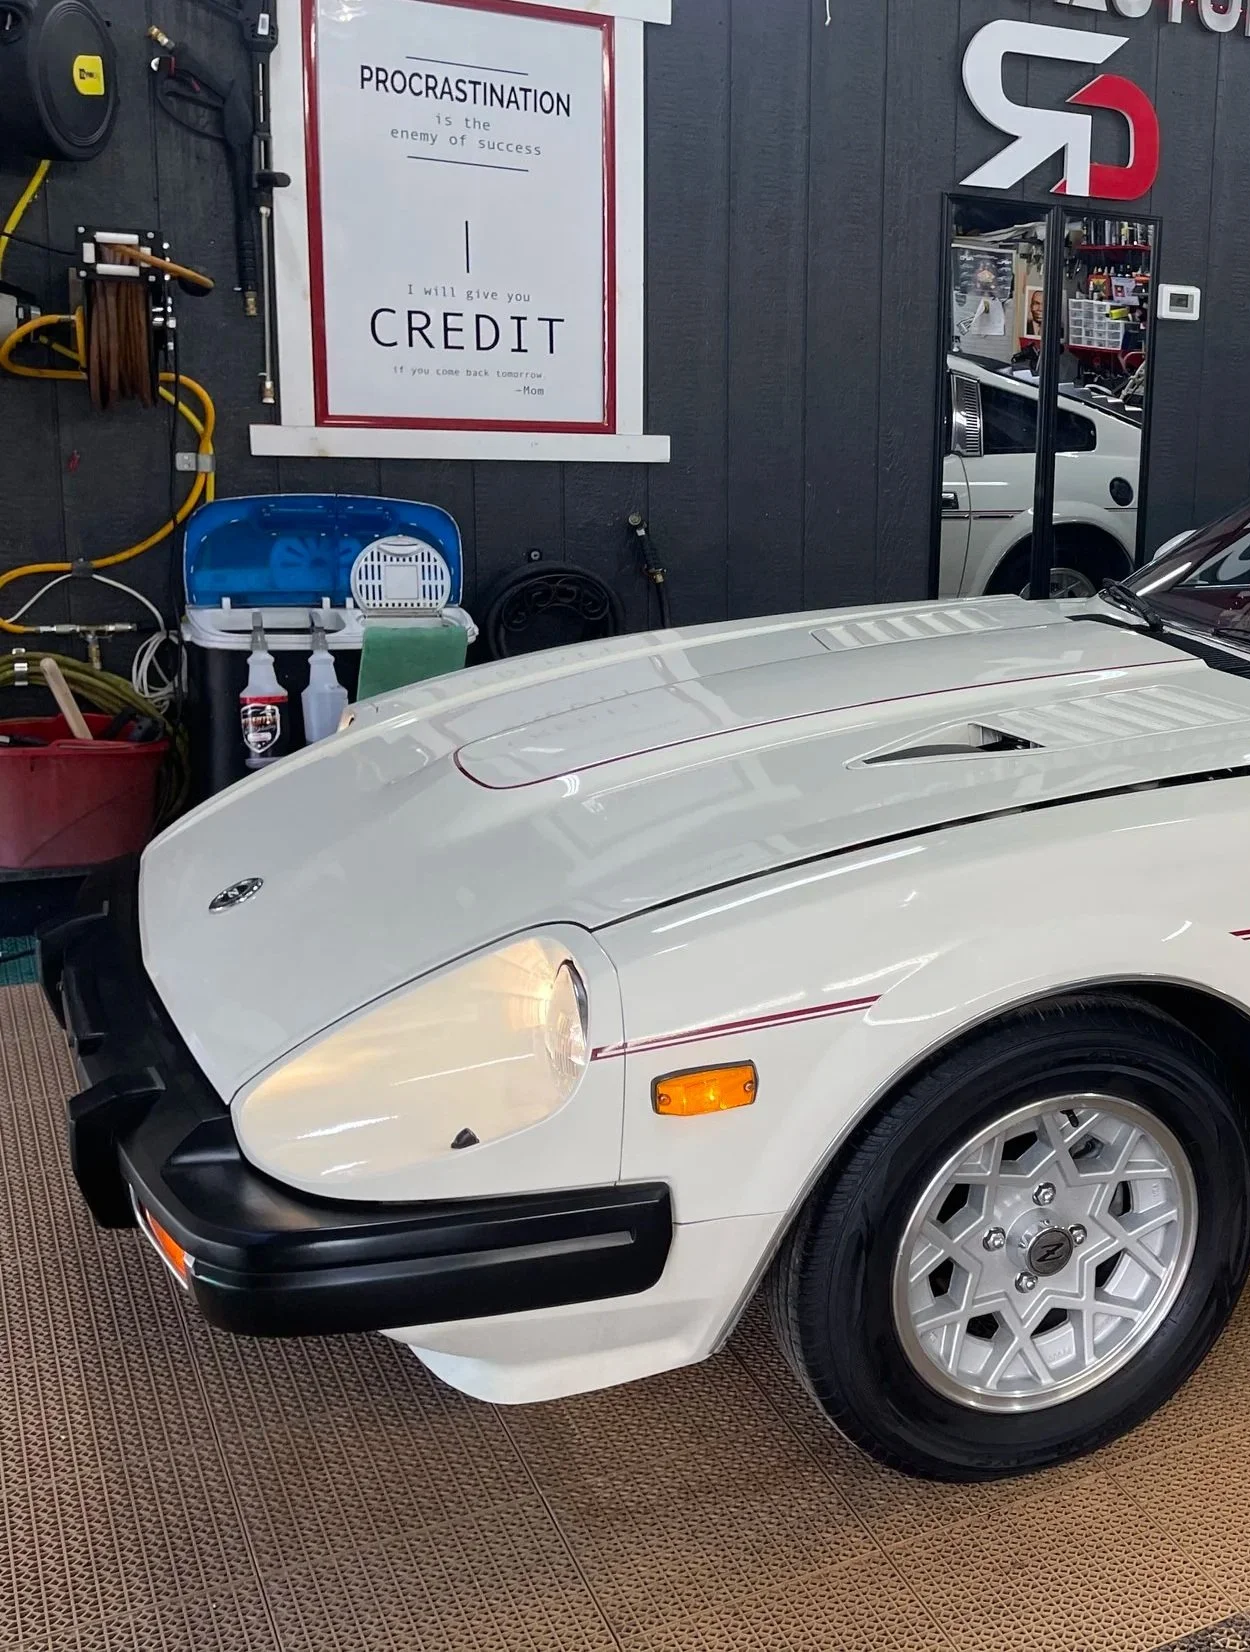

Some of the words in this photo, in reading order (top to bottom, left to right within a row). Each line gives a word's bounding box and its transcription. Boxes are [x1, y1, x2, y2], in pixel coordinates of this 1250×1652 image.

[360, 65, 570, 117] PROCRASTINATION
[435, 113, 452, 126] is
[464, 117, 491, 131] the
[390, 127, 438, 146] enemy
[449, 134, 467, 146] of
[478, 138, 542, 156] success
[407, 284, 414, 294] I
[424, 286, 456, 298] will
[466, 288, 498, 301] give
[507, 292, 530, 303] you
[370, 307, 565, 354] CREDIT
[411, 367, 430, 376] you
[436, 368, 460, 376] come
[466, 369, 489, 377] back
